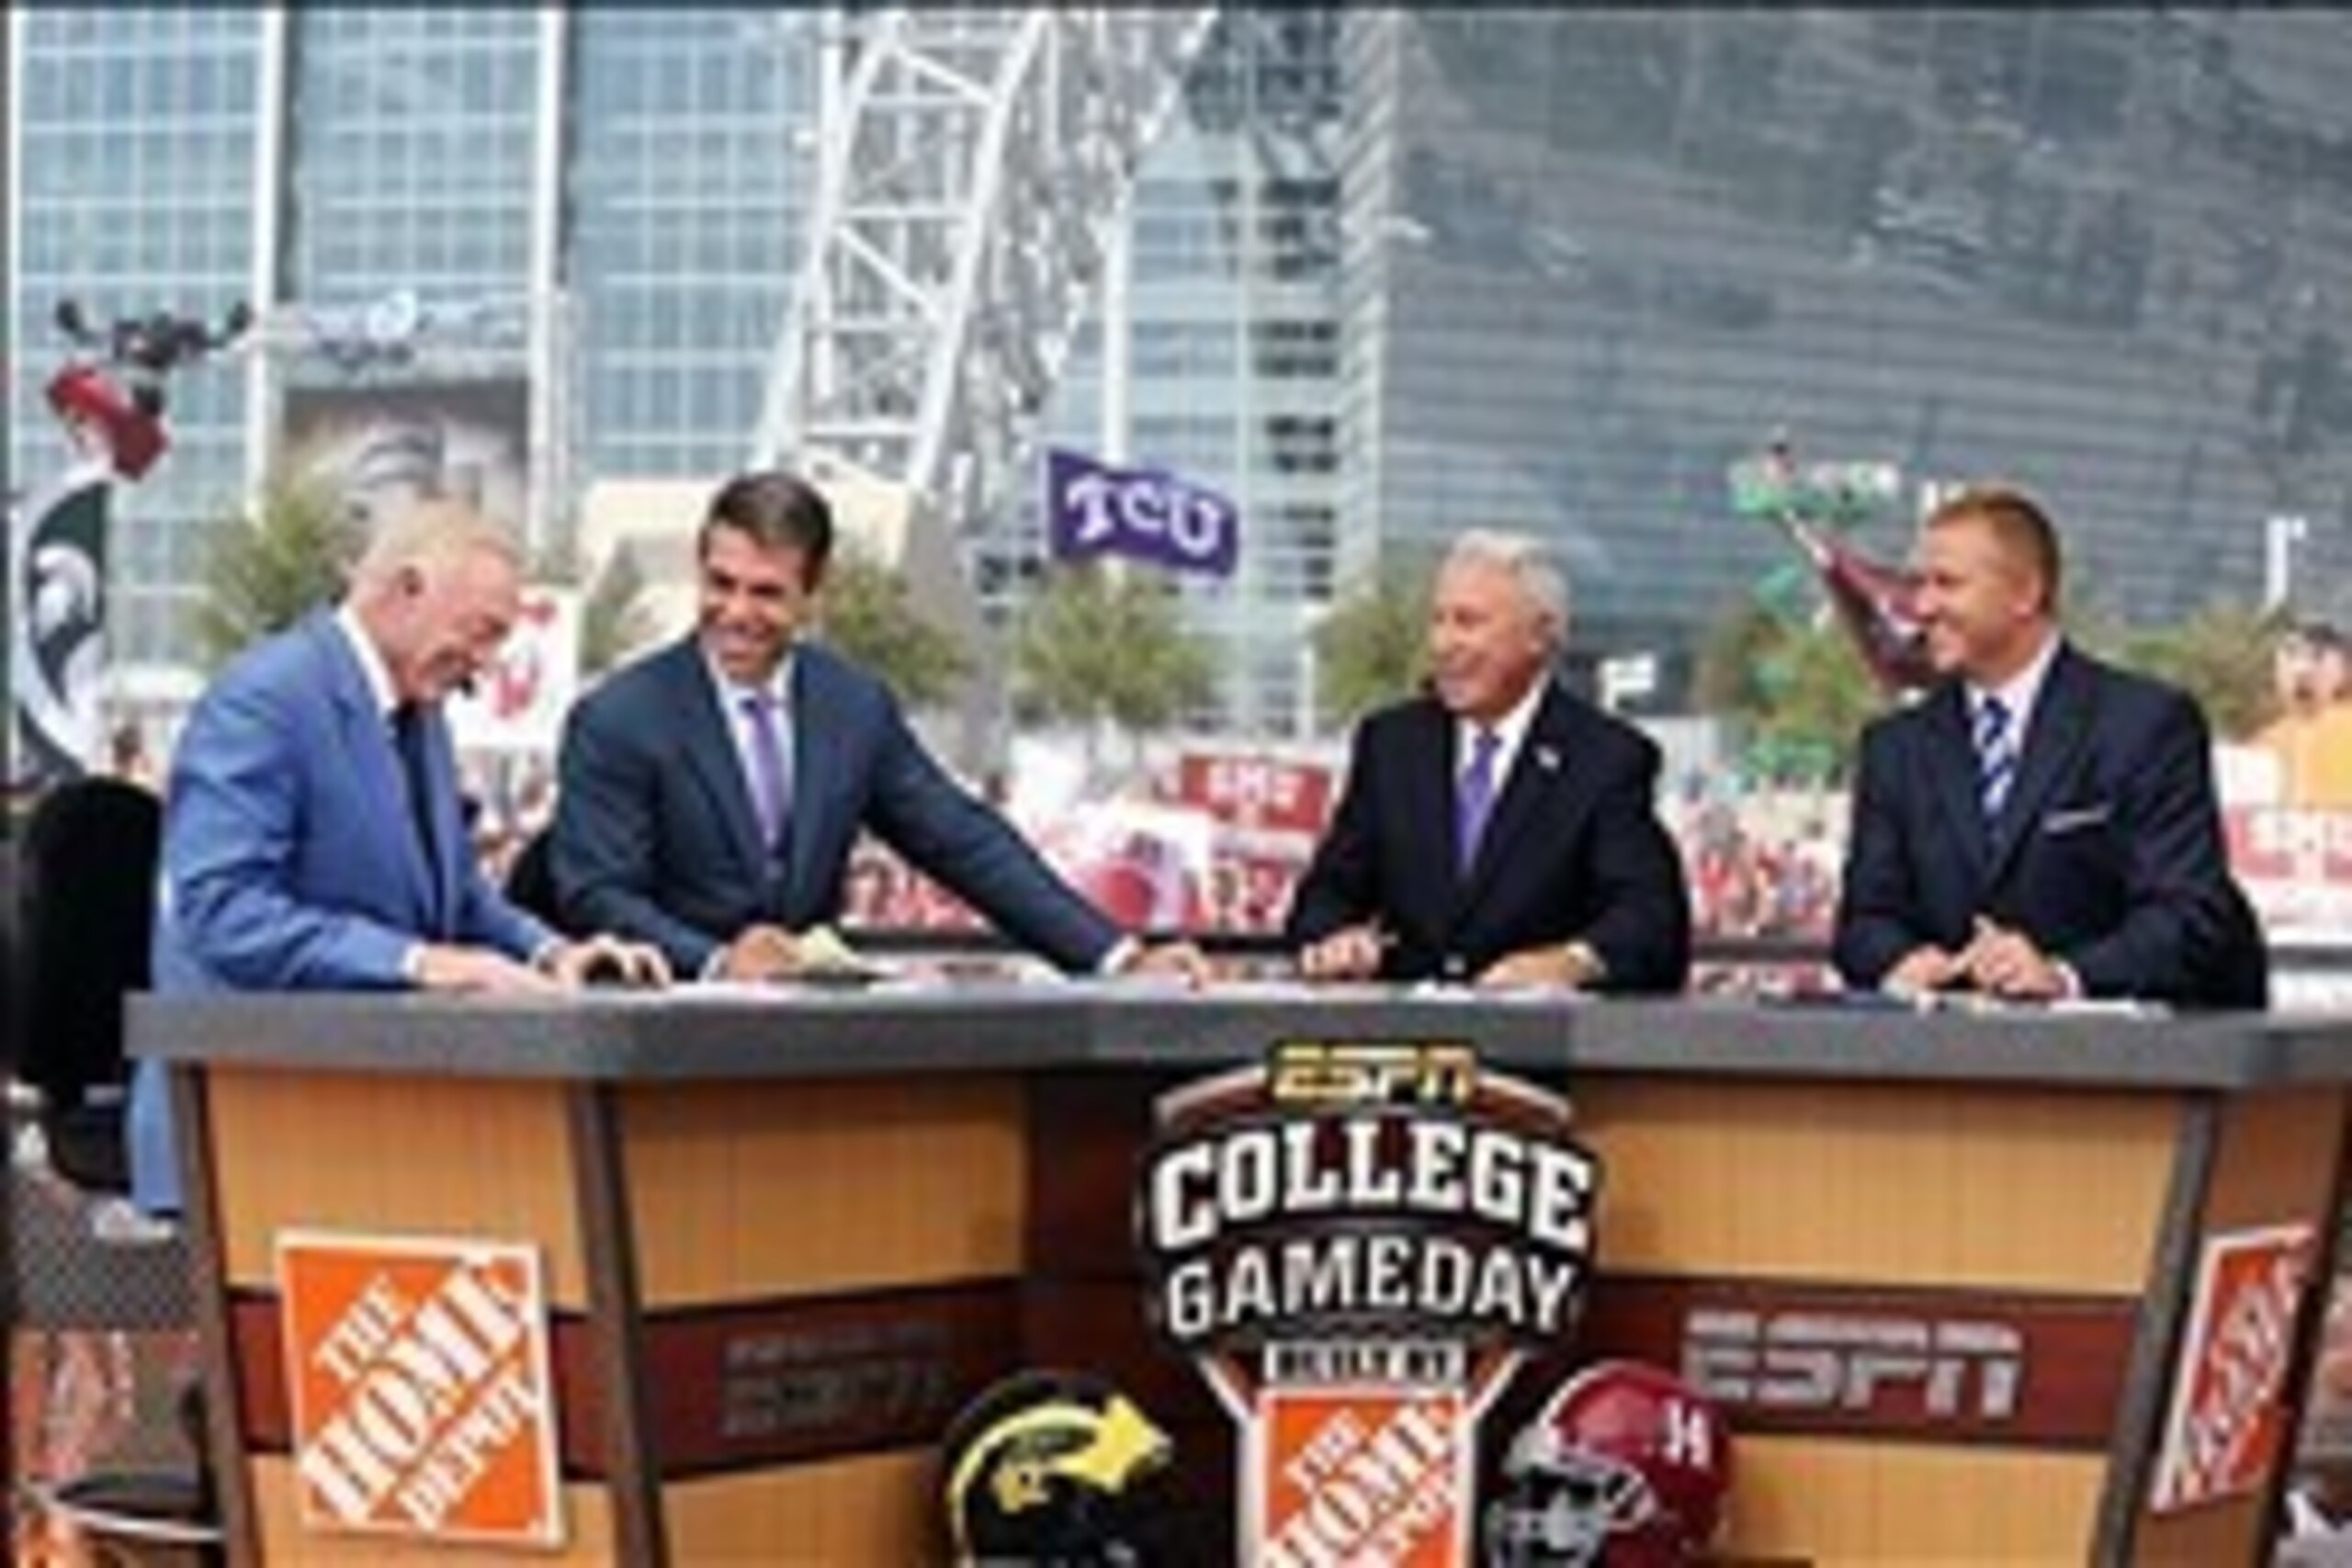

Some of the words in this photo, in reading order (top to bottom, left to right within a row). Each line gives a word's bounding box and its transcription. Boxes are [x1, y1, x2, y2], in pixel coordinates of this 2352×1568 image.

[1066, 474, 1222, 555] TCU
[1273, 1045, 1476, 1100] ESPN
[1152, 1121, 1591, 1250] COLLEGE
[311, 1273, 406, 1385] THE
[1168, 1235, 1577, 1336] GAMEDAY
[300, 1251, 537, 1527] HOME
[1682, 1311, 2021, 1420] ESPN
